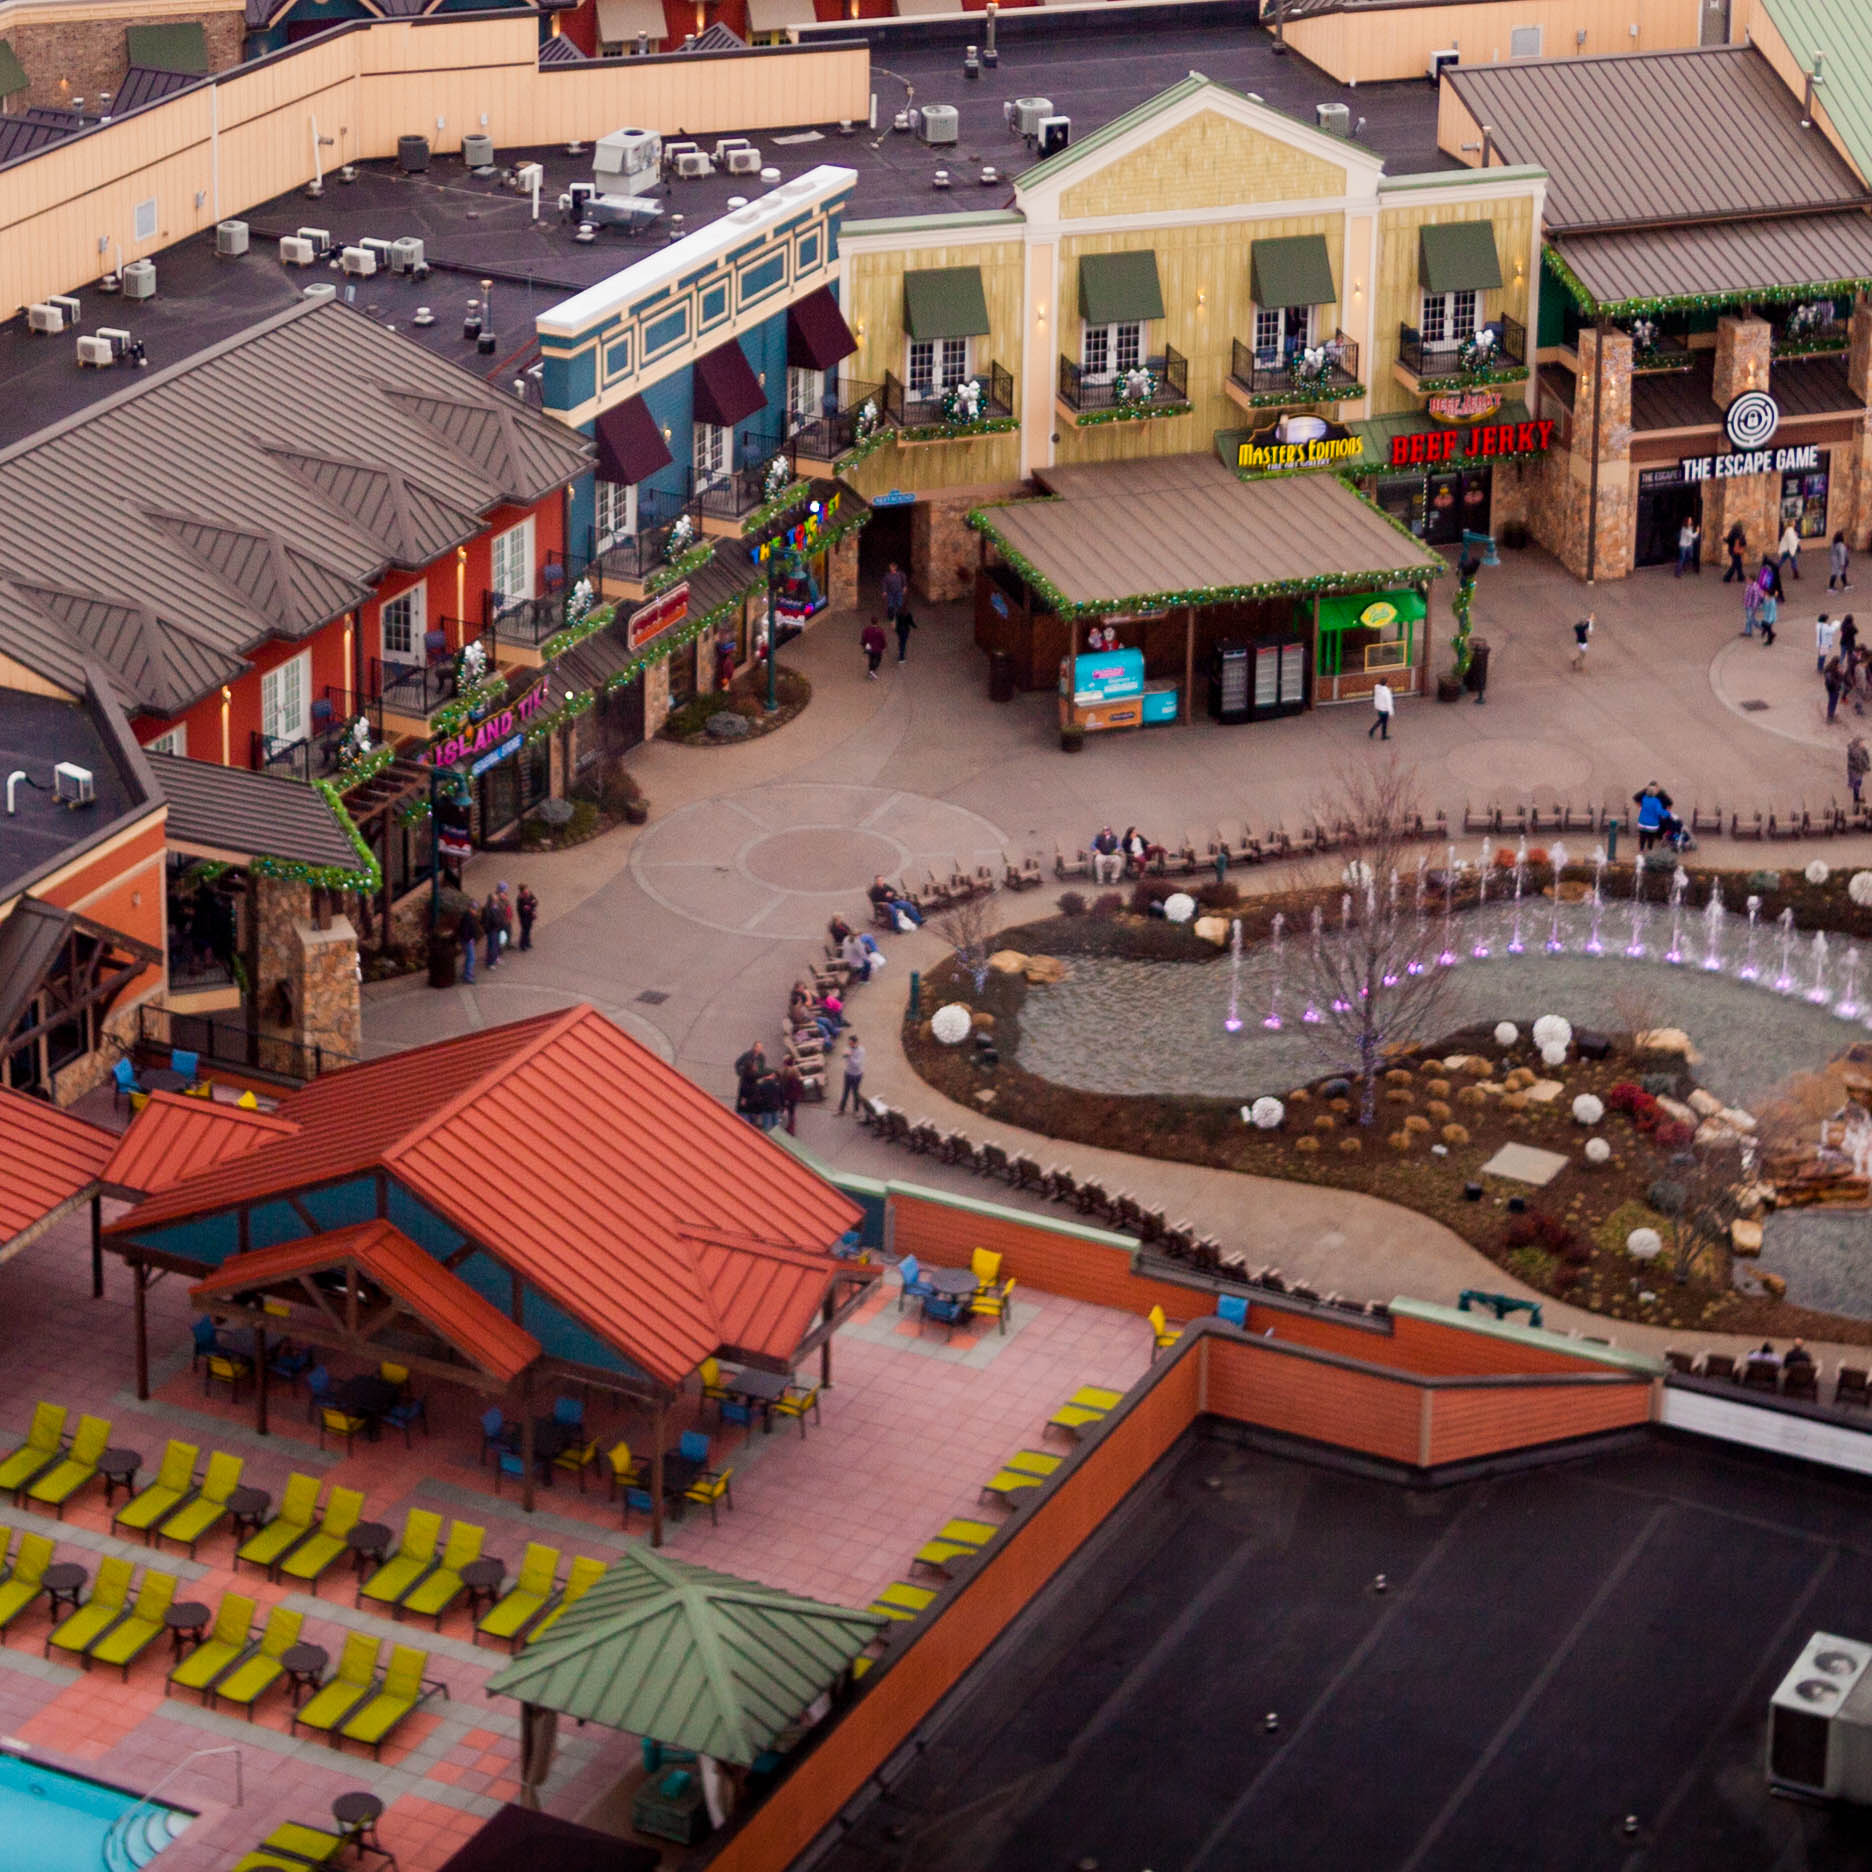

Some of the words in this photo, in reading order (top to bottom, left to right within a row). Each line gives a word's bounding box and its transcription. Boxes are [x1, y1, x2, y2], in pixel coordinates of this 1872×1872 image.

[1238, 442, 1306, 466] MASTER'S
[1308, 435, 1364, 463] EDITIONS
[1391, 430, 1458, 465] BEEF
[1465, 419, 1555, 457] JERKY
[1683, 457, 1711, 481] THE
[1715, 449, 1772, 478] ESCAPE
[1776, 445, 1819, 470] GAME
[435, 711, 513, 767] ISLAND
